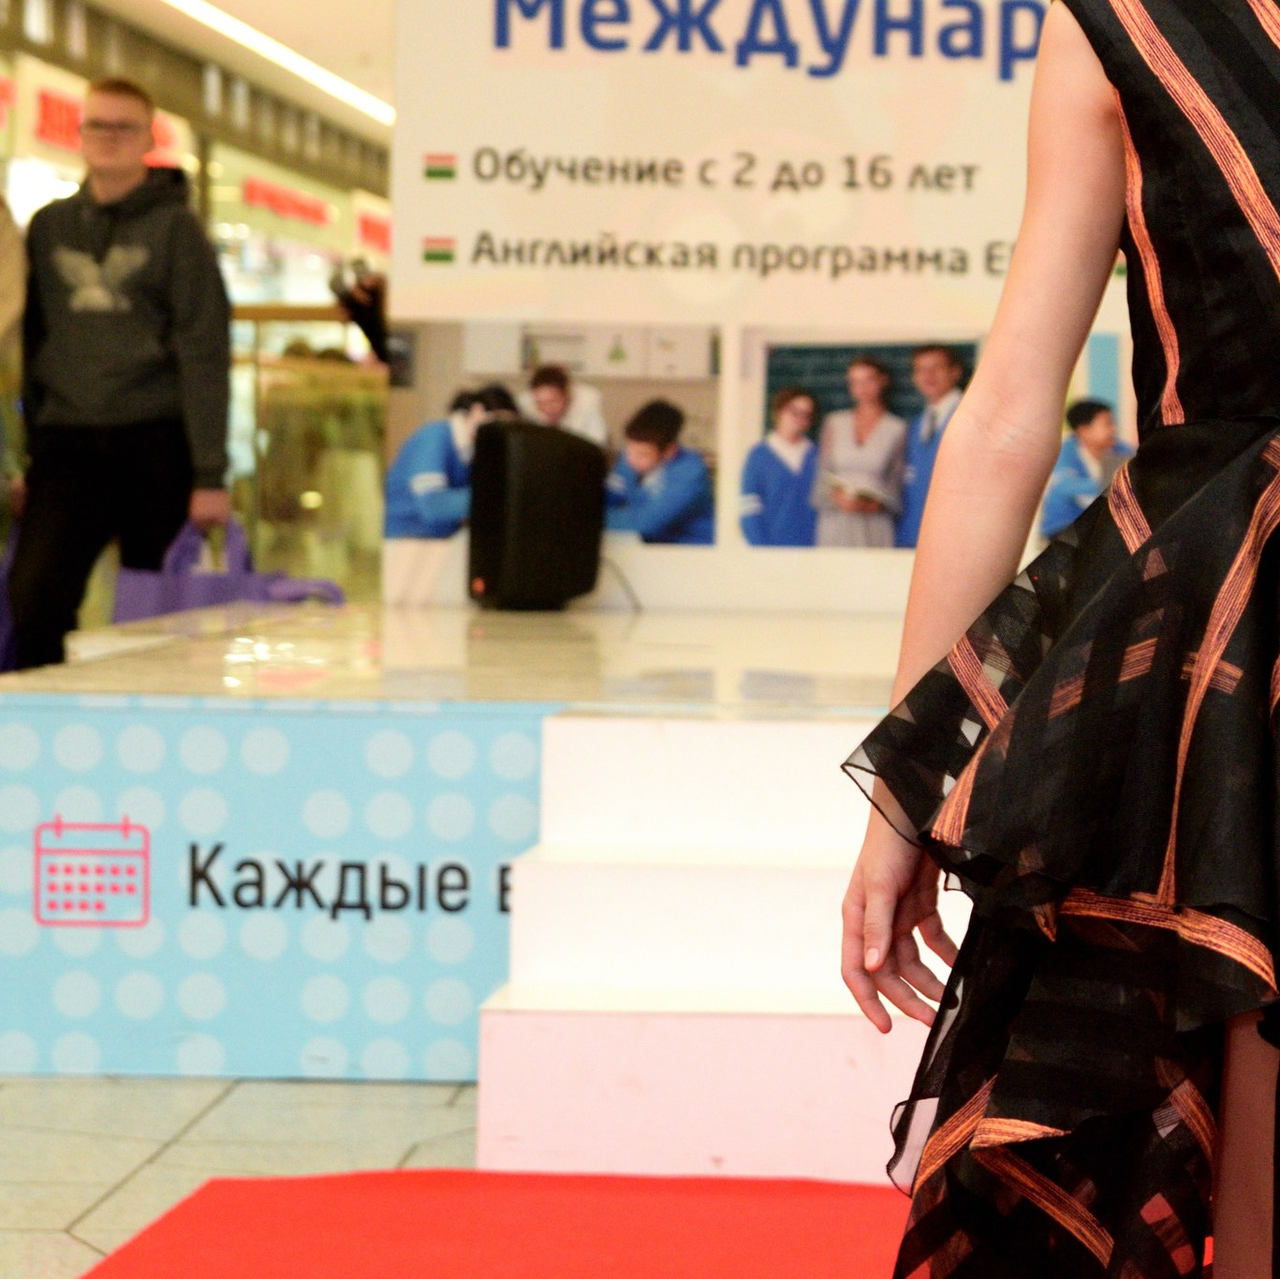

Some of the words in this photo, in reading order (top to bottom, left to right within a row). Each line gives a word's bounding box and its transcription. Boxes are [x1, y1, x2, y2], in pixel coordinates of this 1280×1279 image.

[471, 146, 684, 192] Обучение
[697, 159, 714, 188] с
[731, 151, 757, 188] 2
[769, 159, 825, 193] до
[842, 153, 894, 192] 16
[907, 163, 979, 193] лет
[470, 230, 718, 270] Английская
[731, 242, 970, 282] программа
[187, 841, 471, 923] Каждые
